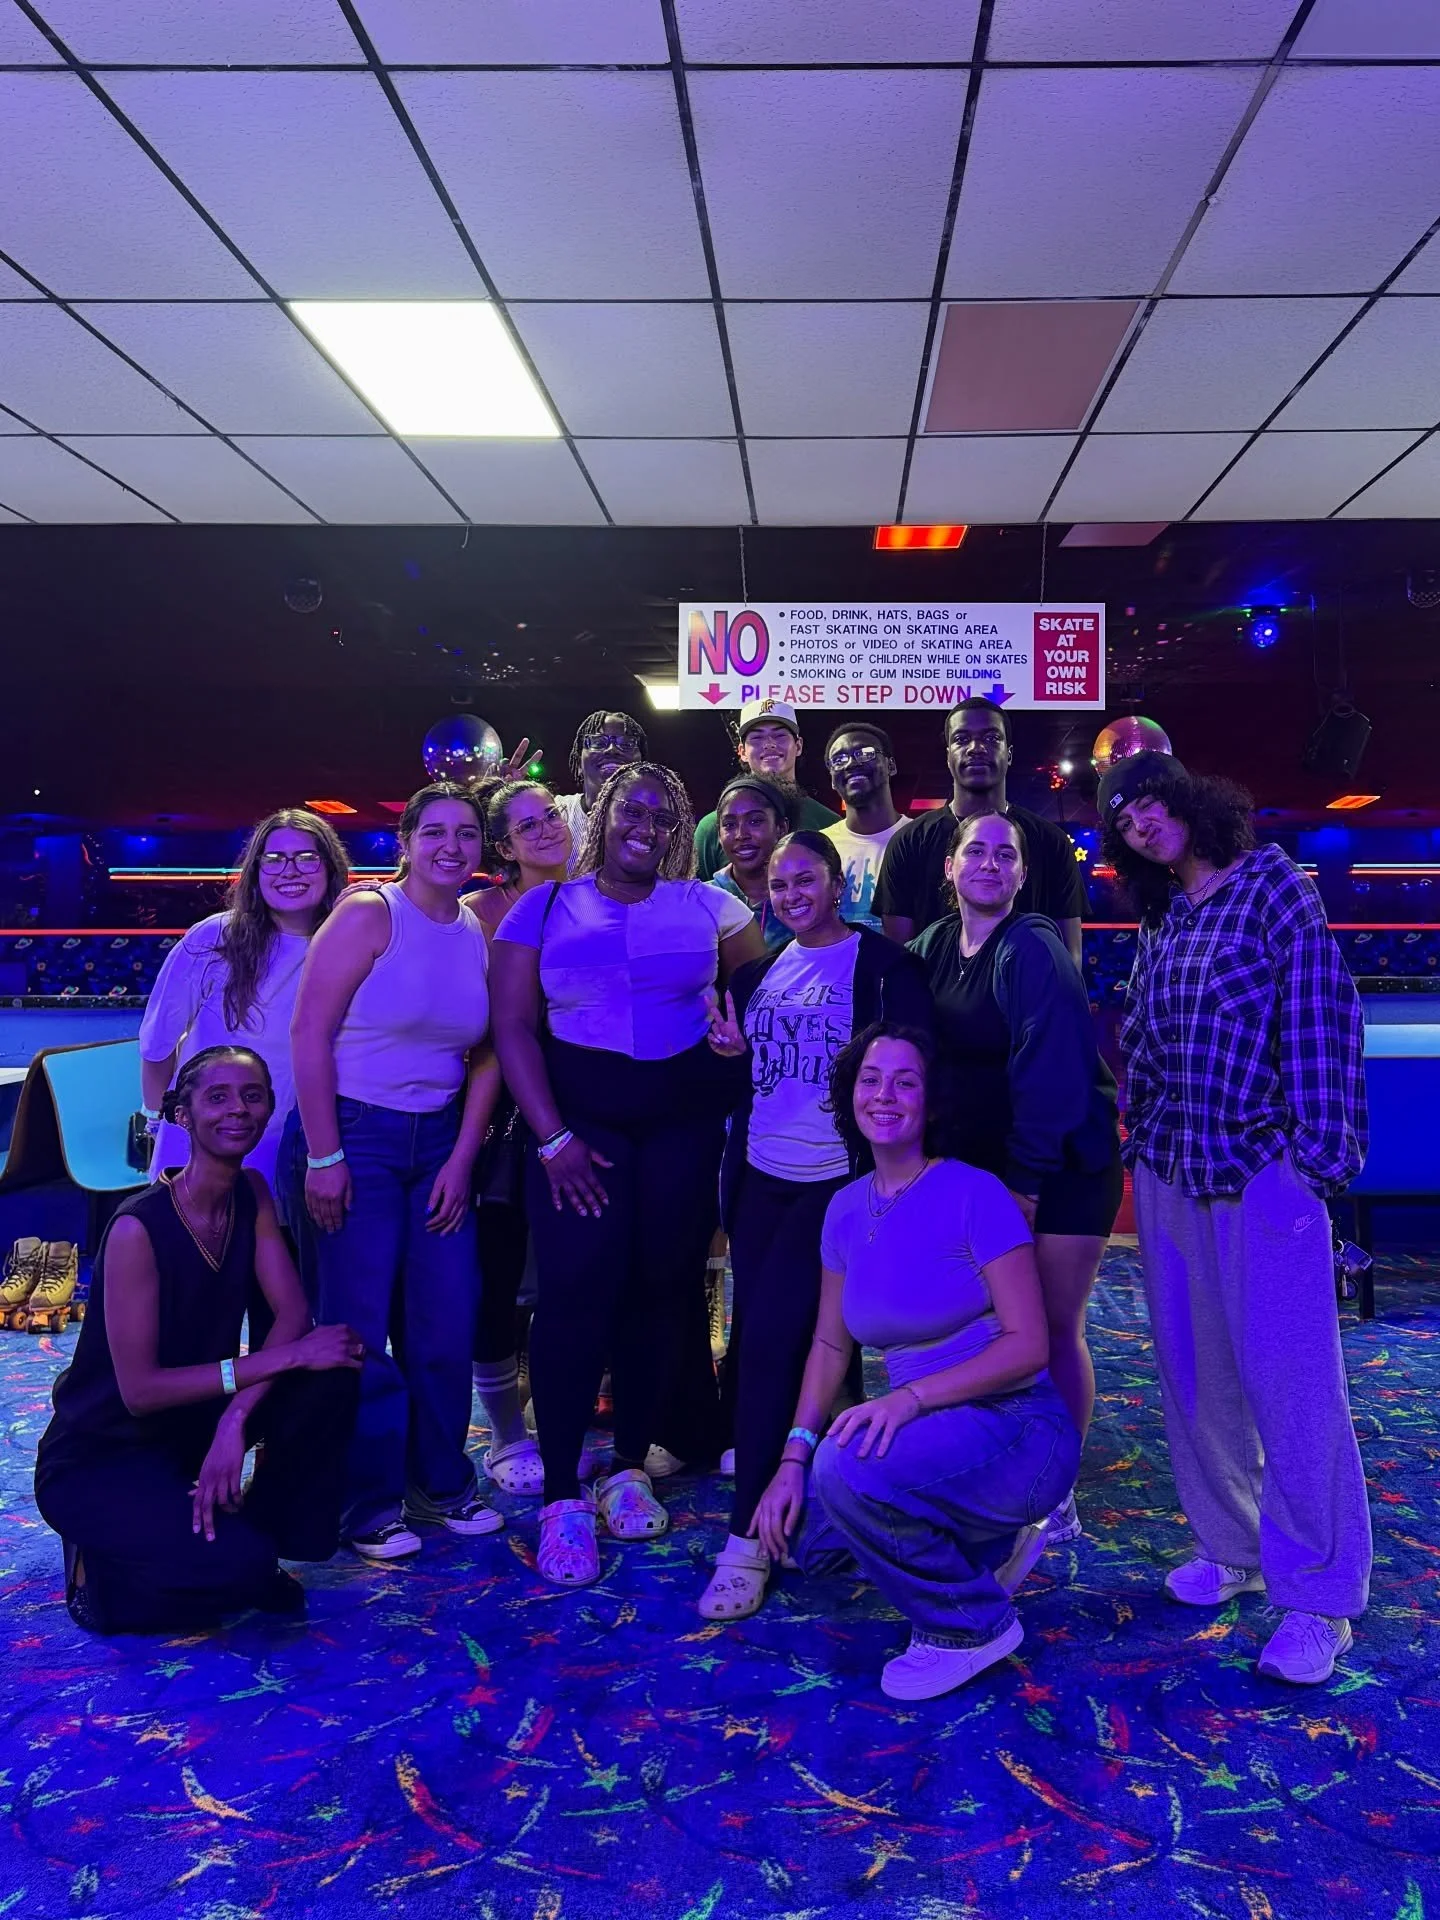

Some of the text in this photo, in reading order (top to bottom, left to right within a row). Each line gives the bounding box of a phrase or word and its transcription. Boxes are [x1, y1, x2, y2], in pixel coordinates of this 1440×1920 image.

[790, 610, 968, 621] FOOD, DRINK, HATS, BAGS or
[790, 624, 998, 635] FAST SKATING ON SKATING AREA
[1039, 617, 1095, 631] SKATE
[688, 610, 770, 677] NO
[790, 639, 1013, 649] PHOTOS or VIDEO of SKATING AREA
[1056, 634, 1077, 647] AT
[790, 654, 1028, 664] CARRYING OF CHILDREN WHILE ON SKATES
[1043, 649, 1090, 663] YOUR
[790, 668, 1002, 679] SMOKING or GUM INSIDE BUILDING
[1046, 665, 1087, 679] OWN
[837, 685, 893, 703] STEP
[904, 685, 971, 704] DOWN
[1045, 681, 1087, 695] RISK
[743, 1007, 852, 1043] OVES
